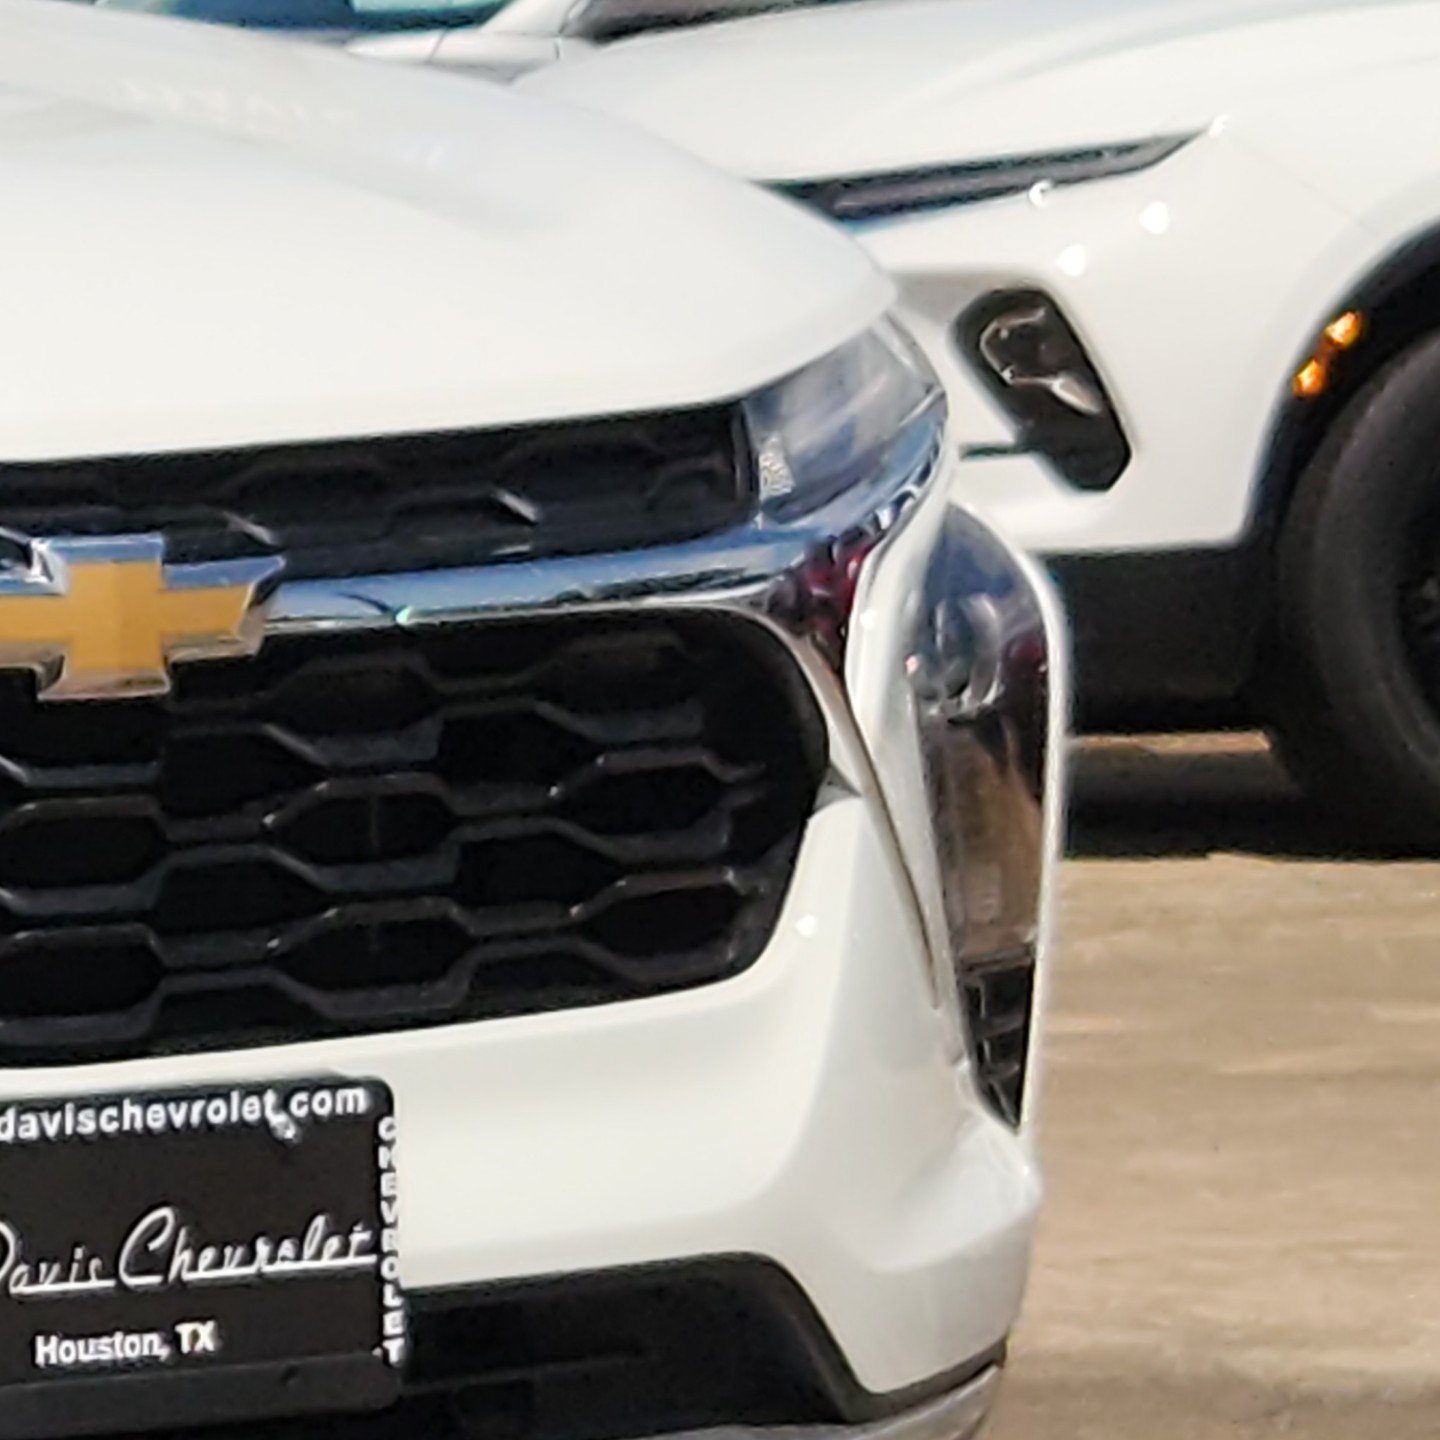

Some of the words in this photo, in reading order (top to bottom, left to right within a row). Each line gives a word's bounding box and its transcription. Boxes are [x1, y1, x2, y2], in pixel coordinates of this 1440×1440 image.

[118, 1205, 378, 1288] Chevrolet
[34, 1331, 170, 1368] Houston,
[176, 1320, 218, 1355] TX
